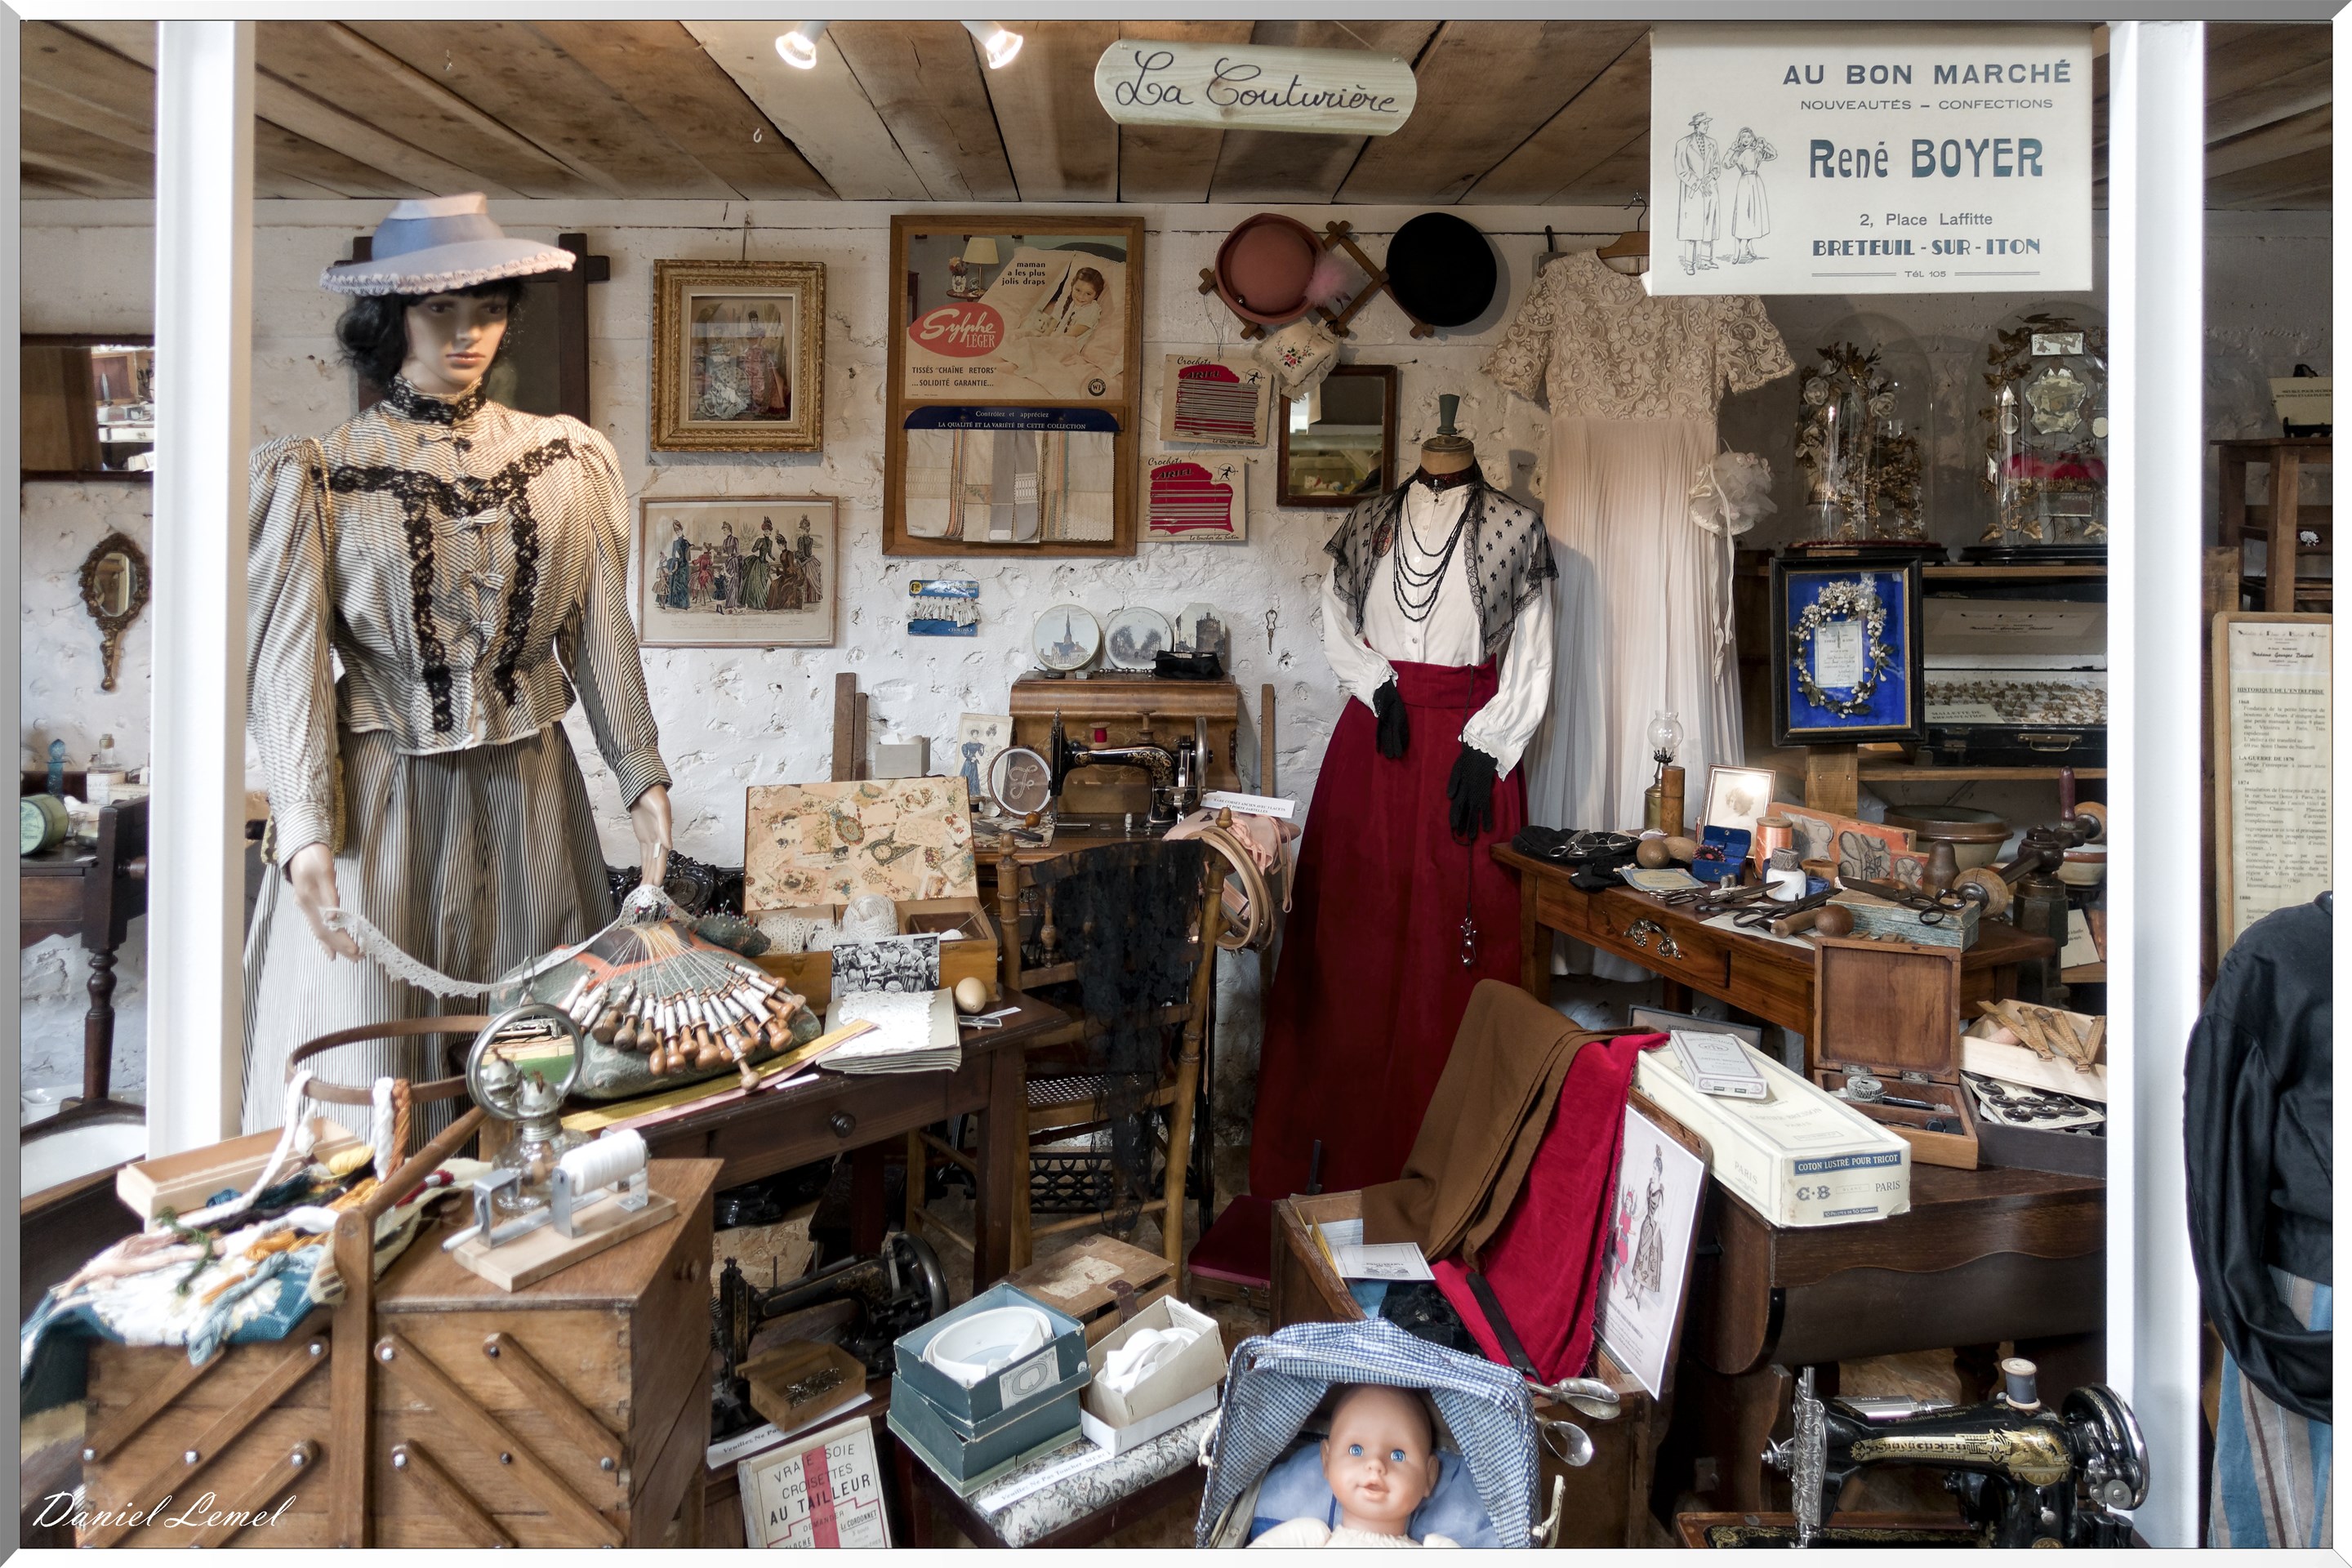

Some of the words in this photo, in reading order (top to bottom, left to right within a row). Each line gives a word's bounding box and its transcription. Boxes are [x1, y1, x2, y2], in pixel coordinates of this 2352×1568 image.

[1783, 65, 1825, 86] AU
[1846, 64, 1913, 85] BON
[1934, 59, 2071, 84] MARCHÉ
[1116, 51, 1194, 106] La
[1206, 57, 1399, 113] Couturière
[1800, 98, 1912, 111] NOUVEAUTÉS
[1938, 98, 2053, 111] CONFECTIONS
[1810, 140, 1889, 179] René
[1912, 138, 2043, 178] BOYER
[1860, 214, 1875, 229] 2,
[1886, 213, 1927, 226] Place
[1939, 212, 1993, 226] Laffitte
[1001, 278, 1019, 286] jolis
[1022, 278, 1045, 286] draps
[1029, 269, 1045, 278] plus
[1927, 270, 1947, 278] 105
[920, 308, 997, 343] Sylphe
[966, 333, 996, 348] LÉGER
[1177, 356, 1211, 365] Crochets
[1148, 457, 1182, 466] Crochets
[1798, 1162, 1822, 1171] COTON
[1824, 1158, 1850, 1169] LUSTRÉ
[1851, 1156, 1871, 1165] POUR
[1873, 1154, 1898, 1164] TRICOT
[1735, 1160, 1757, 1184] PARIS
[1875, 1180, 1900, 1192] PARIS
[754, 1432, 765, 1443] Ne
[1878, 1441, 1962, 1454] SINGER
[774, 1454, 814, 1483] VRAIE
[826, 1444, 854, 1459] SOIE
[782, 1463, 853, 1499] CROISETTES
[770, 1506, 788, 1526] AU
[797, 1473, 871, 1513] TAILLEUR
[803, 1510, 844, 1532] DEMANDER
